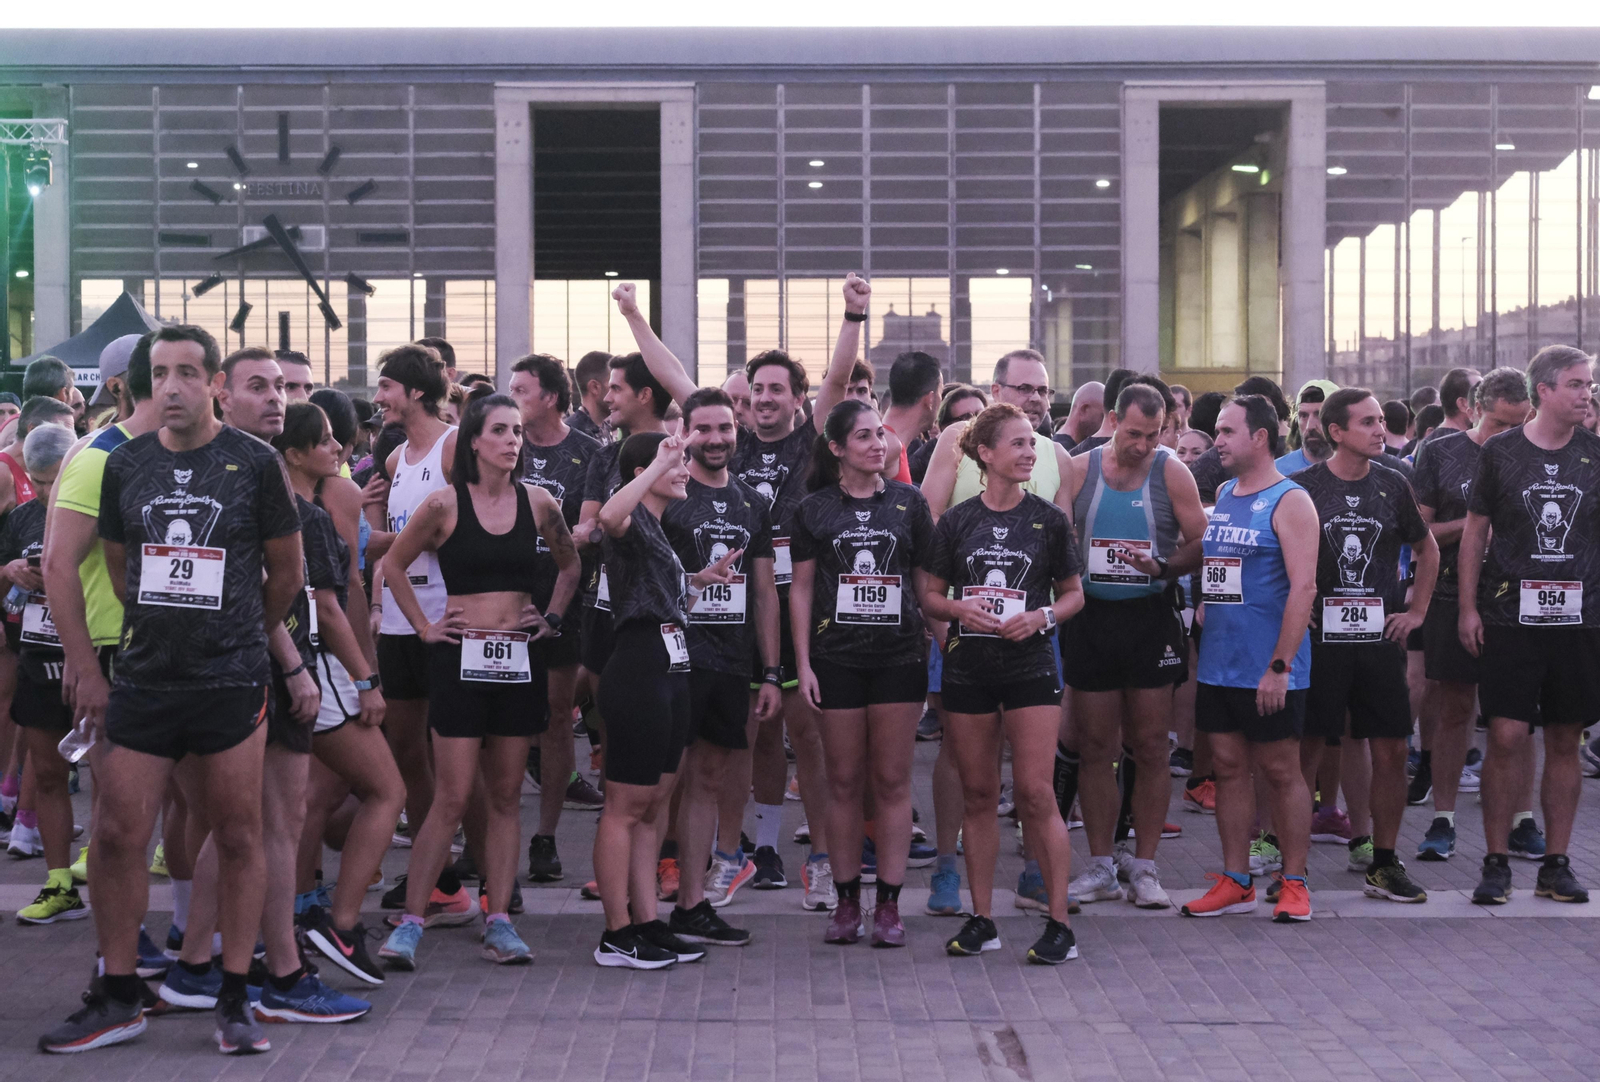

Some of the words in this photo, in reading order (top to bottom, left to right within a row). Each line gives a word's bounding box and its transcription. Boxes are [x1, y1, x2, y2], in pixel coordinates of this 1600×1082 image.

[246, 182, 321, 195] FESTINA
[421, 467, 431, 481] in
[521, 476, 539, 486] nning
[387, 509, 411, 533] ind
[1215, 522, 1260, 547] FÉNIX
[169, 558, 194, 580] 29
[1207, 567, 1226, 583] 568
[702, 585, 732, 602] 1145
[852, 585, 887, 603] 1159
[1538, 590, 1565, 606] 954
[1341, 606, 1368, 623] 284
[483, 641, 512, 660] 661
